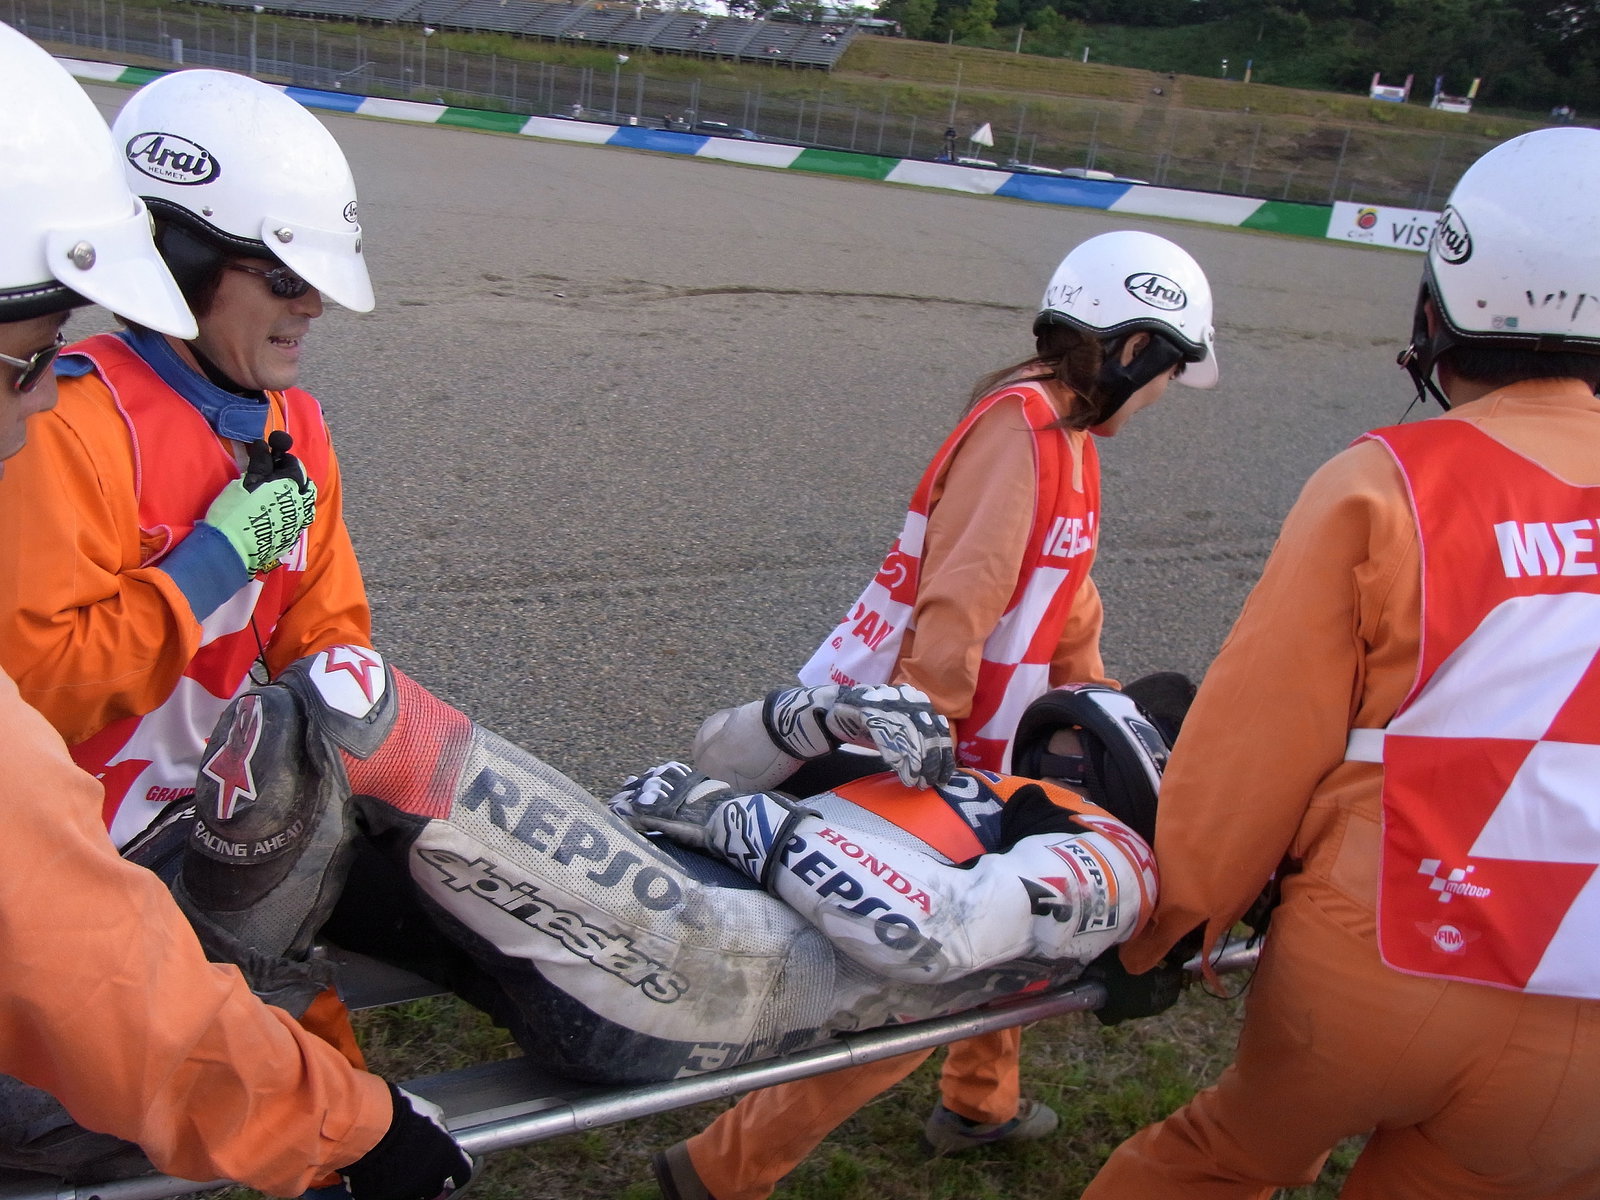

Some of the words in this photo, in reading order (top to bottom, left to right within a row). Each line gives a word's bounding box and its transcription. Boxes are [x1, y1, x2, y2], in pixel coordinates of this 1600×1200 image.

[129, 135, 208, 176] Arai
[148, 166, 184, 181] HELMET
[1436, 211, 1470, 256] Arai
[1129, 276, 1184, 305] Arai
[1493, 519, 1600, 578] ME
[195, 820, 248, 857] RACING
[252, 820, 304, 856] AHEAD
[815, 827, 934, 918] HONDA
[1438, 929, 1461, 945] FIM
